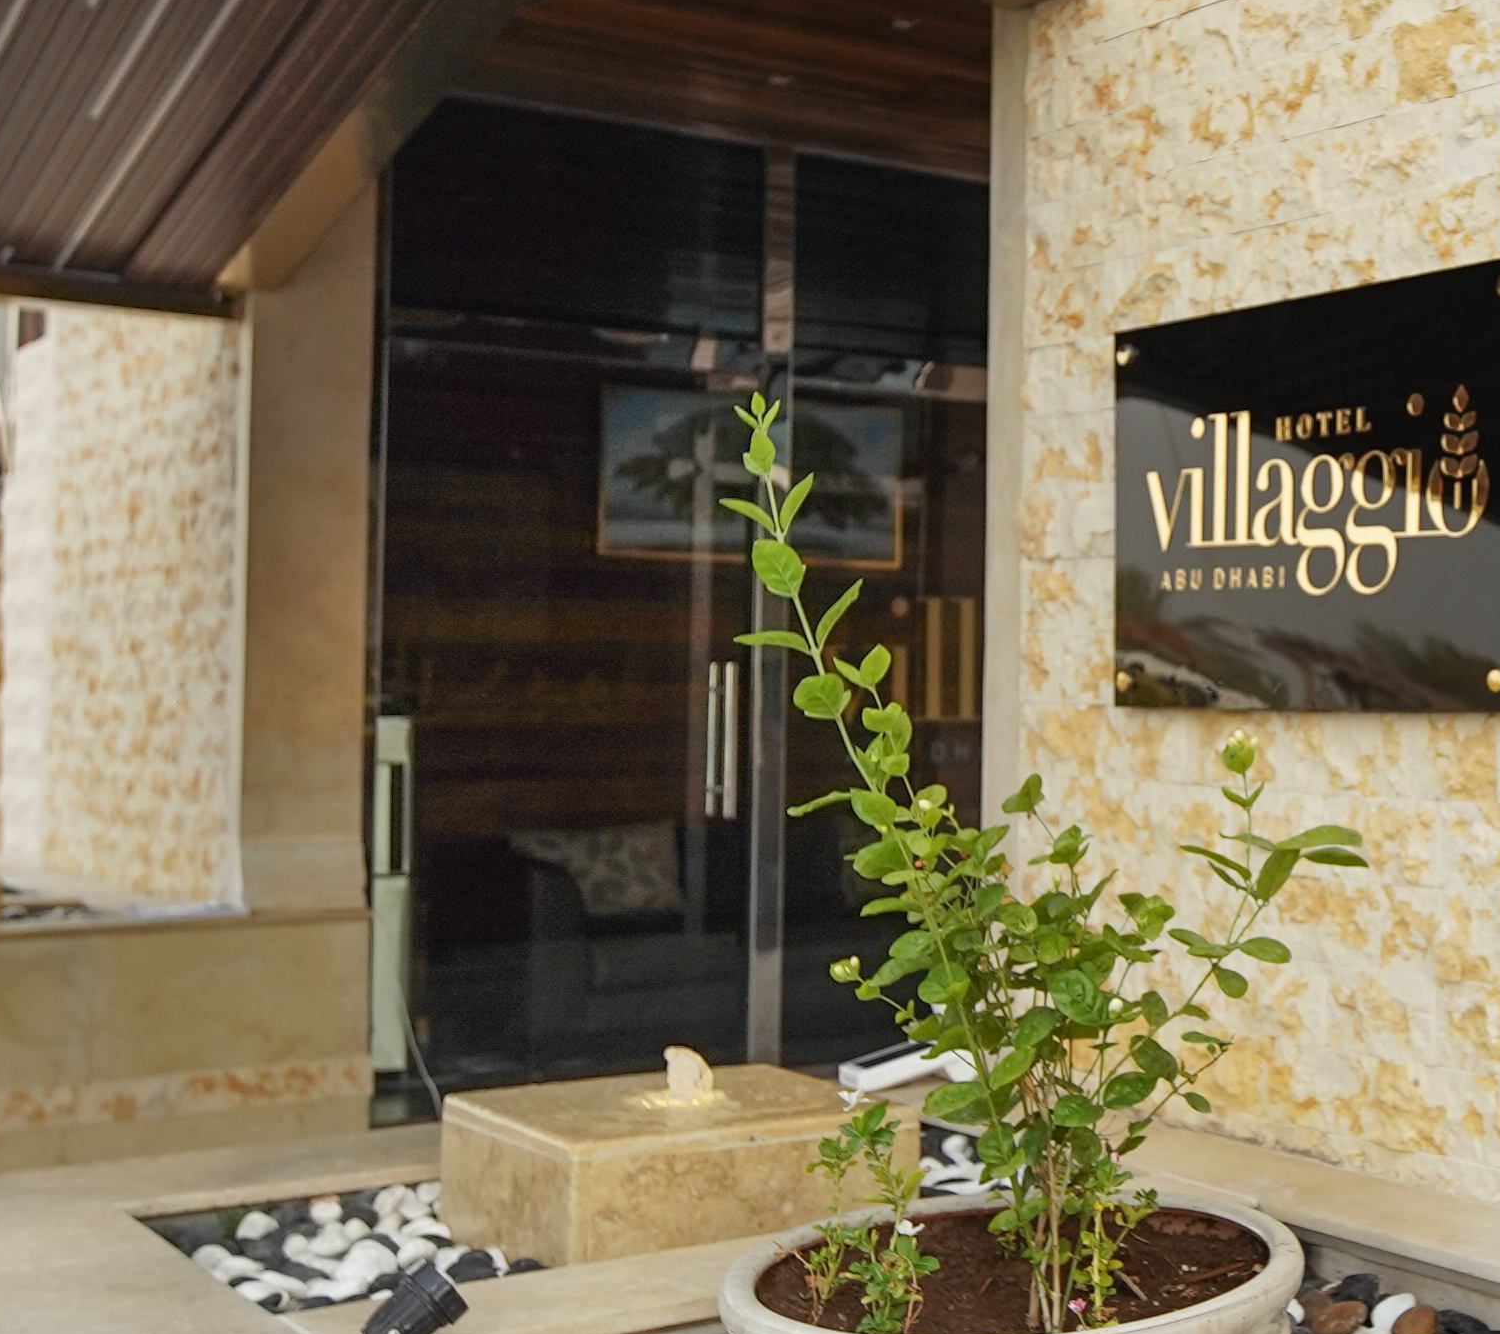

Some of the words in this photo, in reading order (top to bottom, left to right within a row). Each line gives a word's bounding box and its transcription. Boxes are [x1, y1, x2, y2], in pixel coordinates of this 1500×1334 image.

[1274, 405, 1374, 443] HOTEL
[1145, 391, 1491, 597] villaggio
[1159, 567, 1204, 593] ABU
[1211, 564, 1288, 591] DHABI
